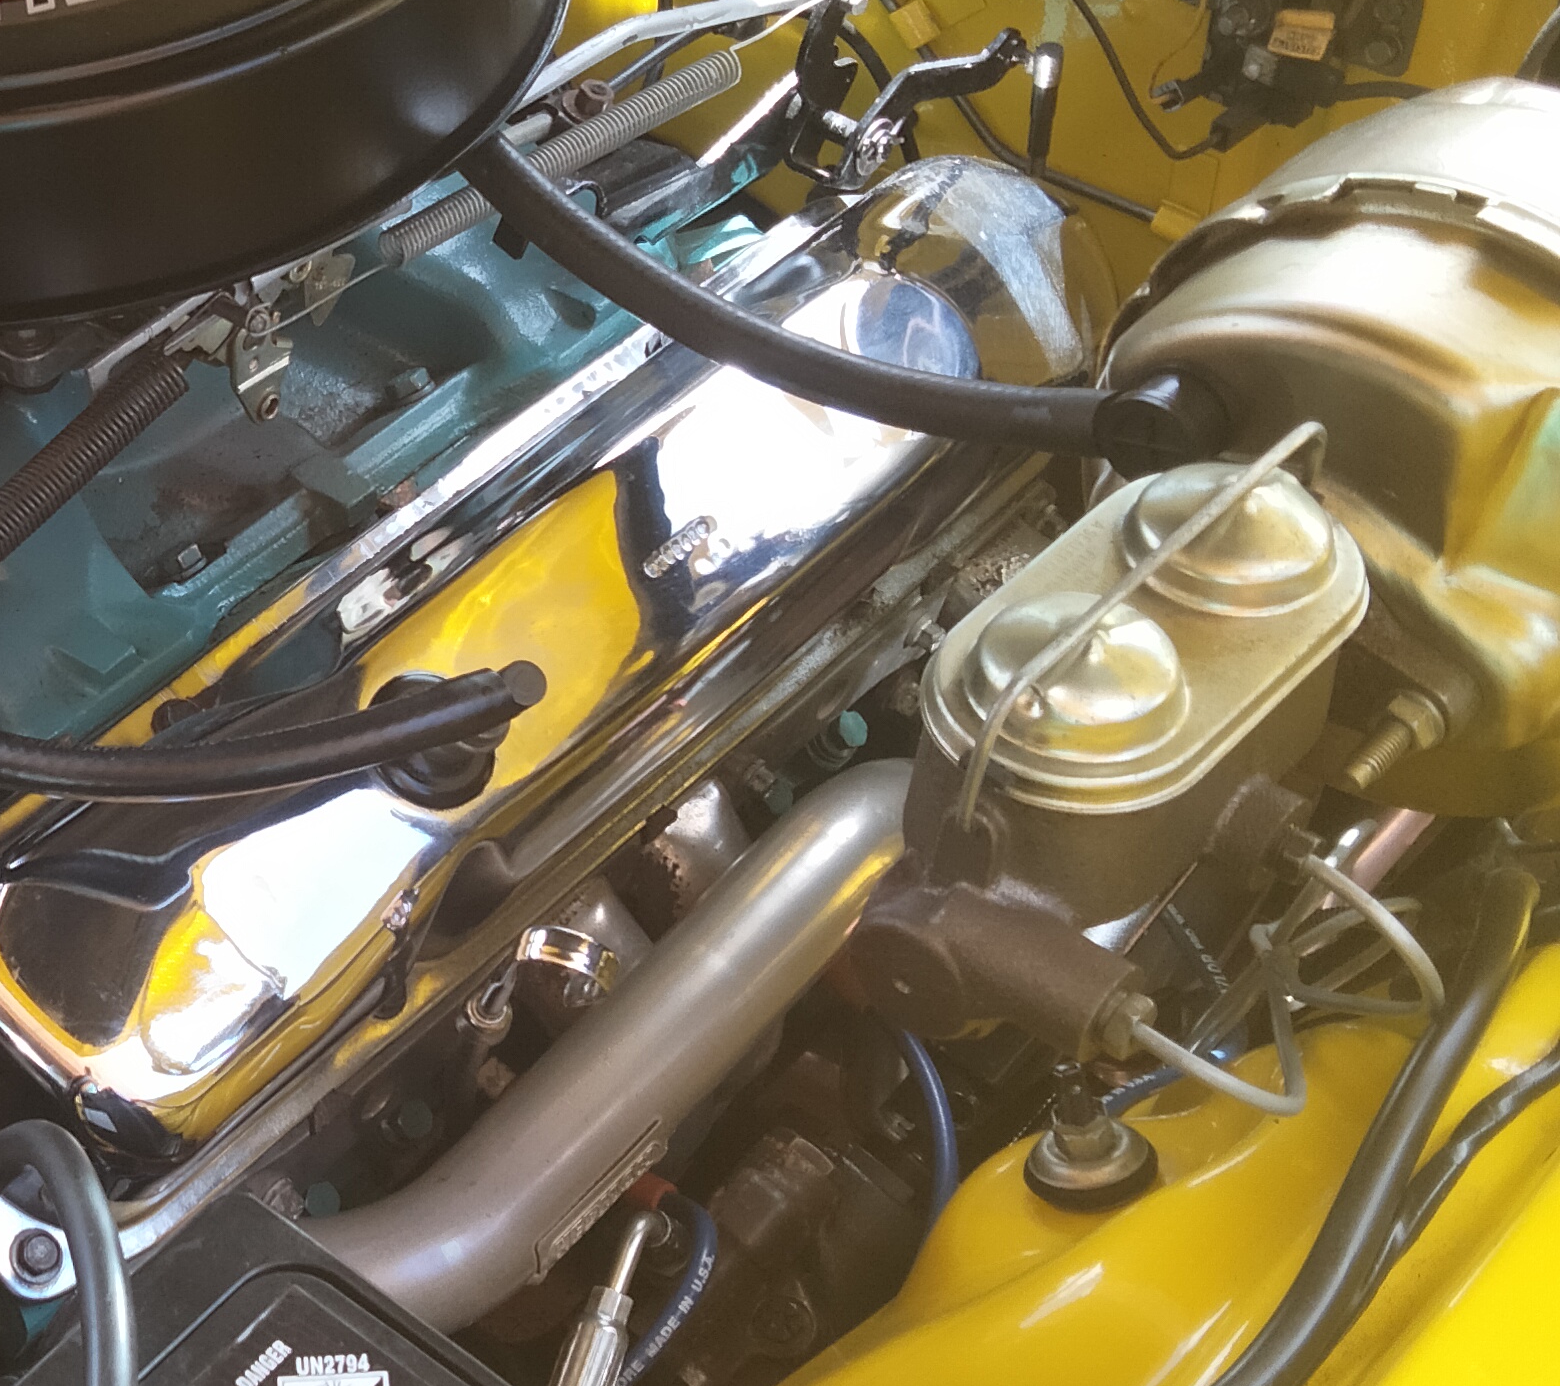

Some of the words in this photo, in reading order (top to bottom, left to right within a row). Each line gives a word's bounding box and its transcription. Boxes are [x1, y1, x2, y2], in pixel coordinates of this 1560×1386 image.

[646, 1316, 682, 1358] MADE
[678, 1298, 695, 1316] IN
[295, 1351, 371, 1377] UN2794
